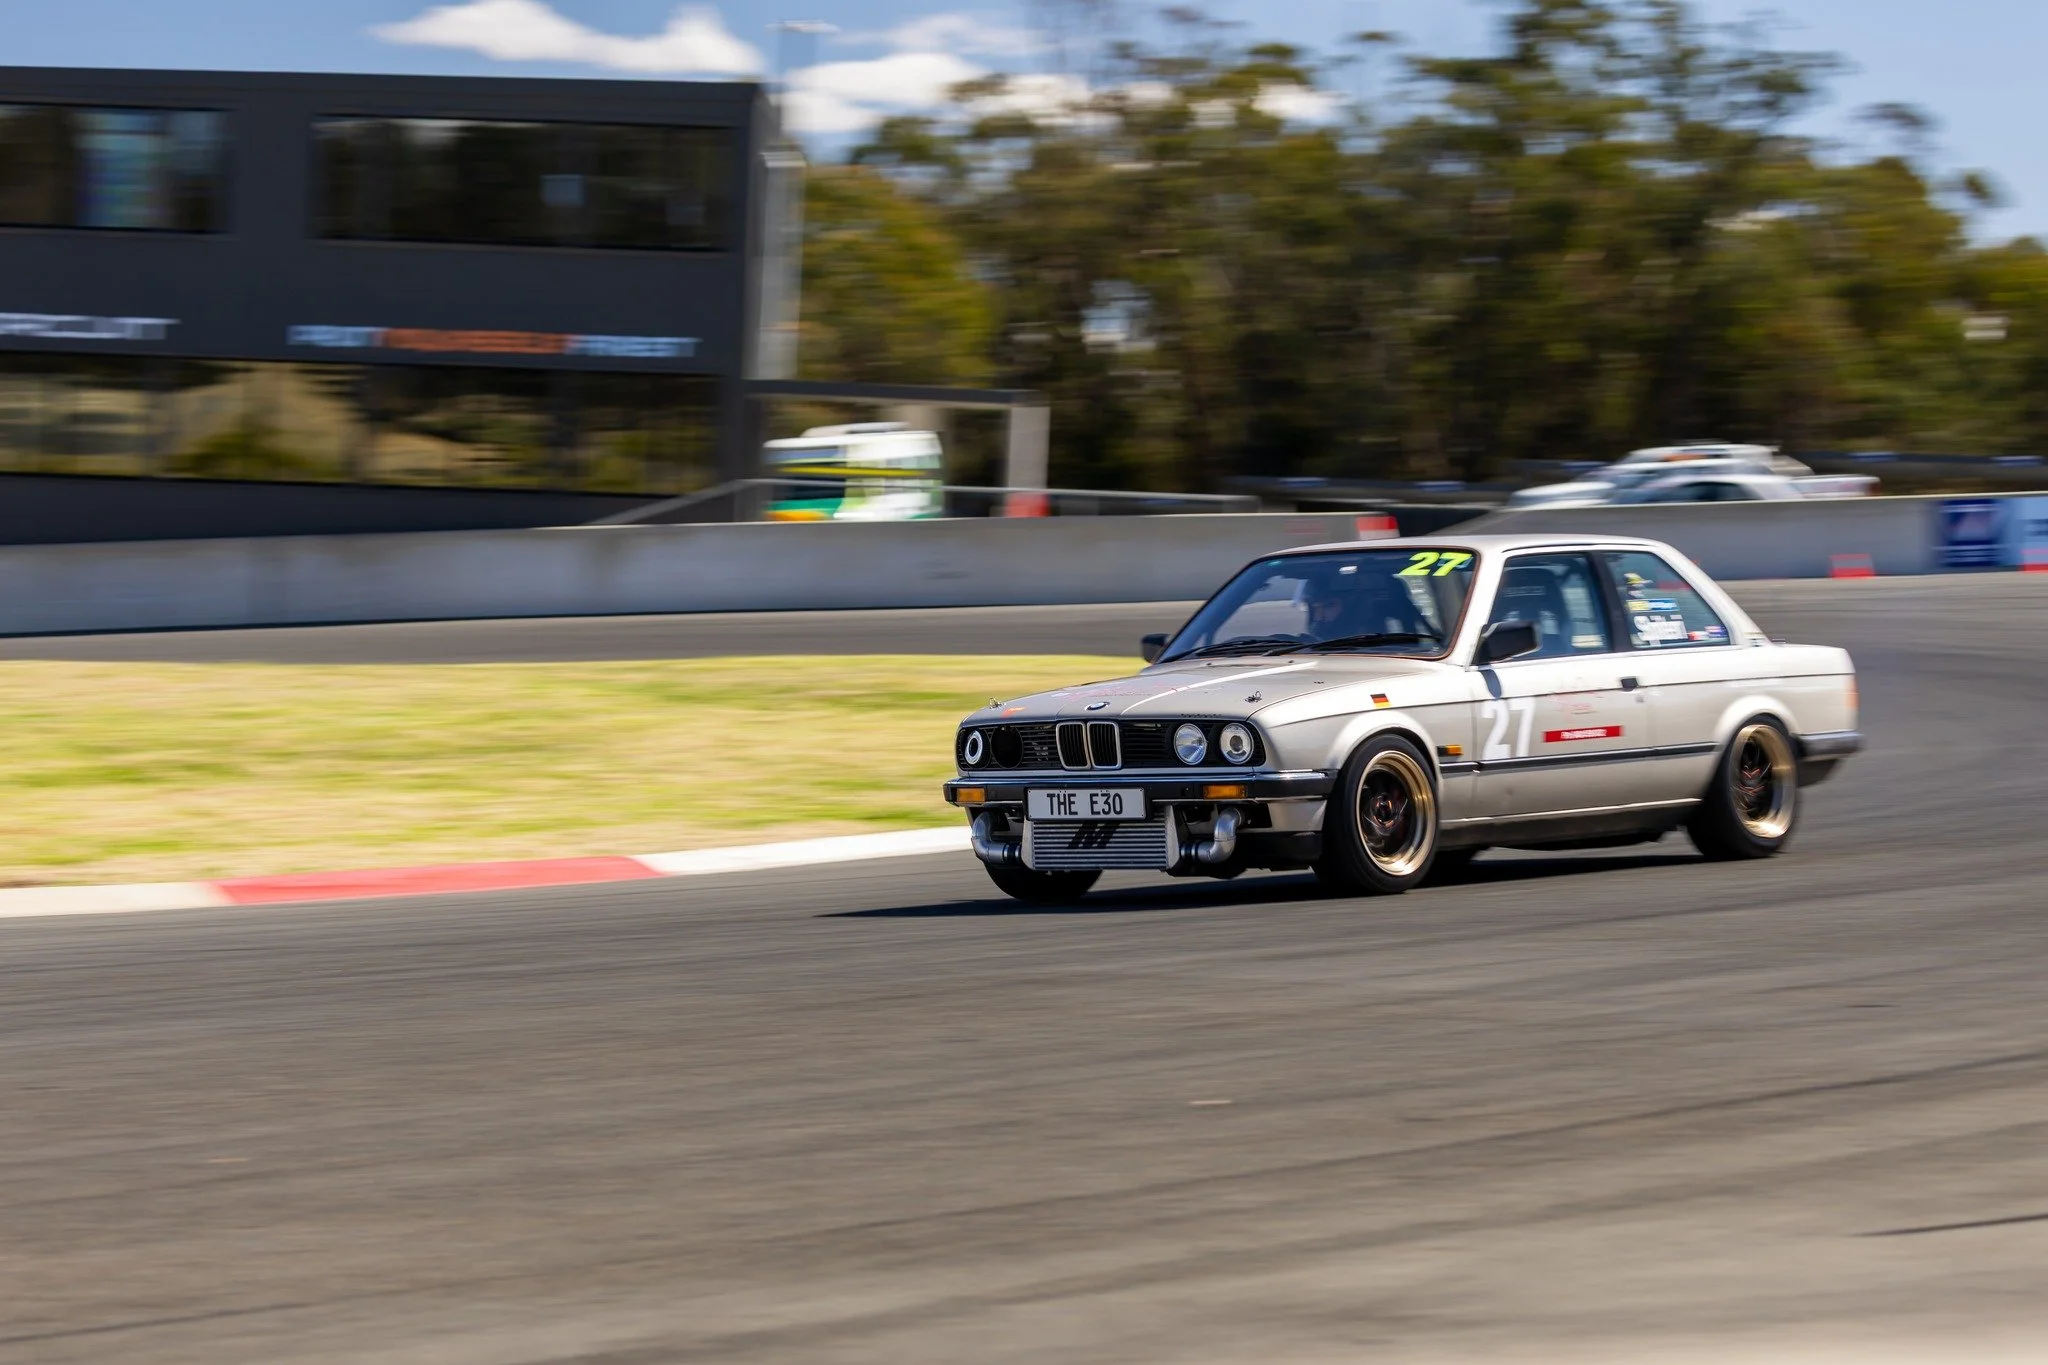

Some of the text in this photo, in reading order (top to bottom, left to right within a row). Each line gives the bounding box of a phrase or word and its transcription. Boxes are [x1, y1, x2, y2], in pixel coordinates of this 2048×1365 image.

[1399, 551, 1472, 577] 27
[1482, 698, 1537, 761] 27
[1046, 792, 1123, 816] THE E30
